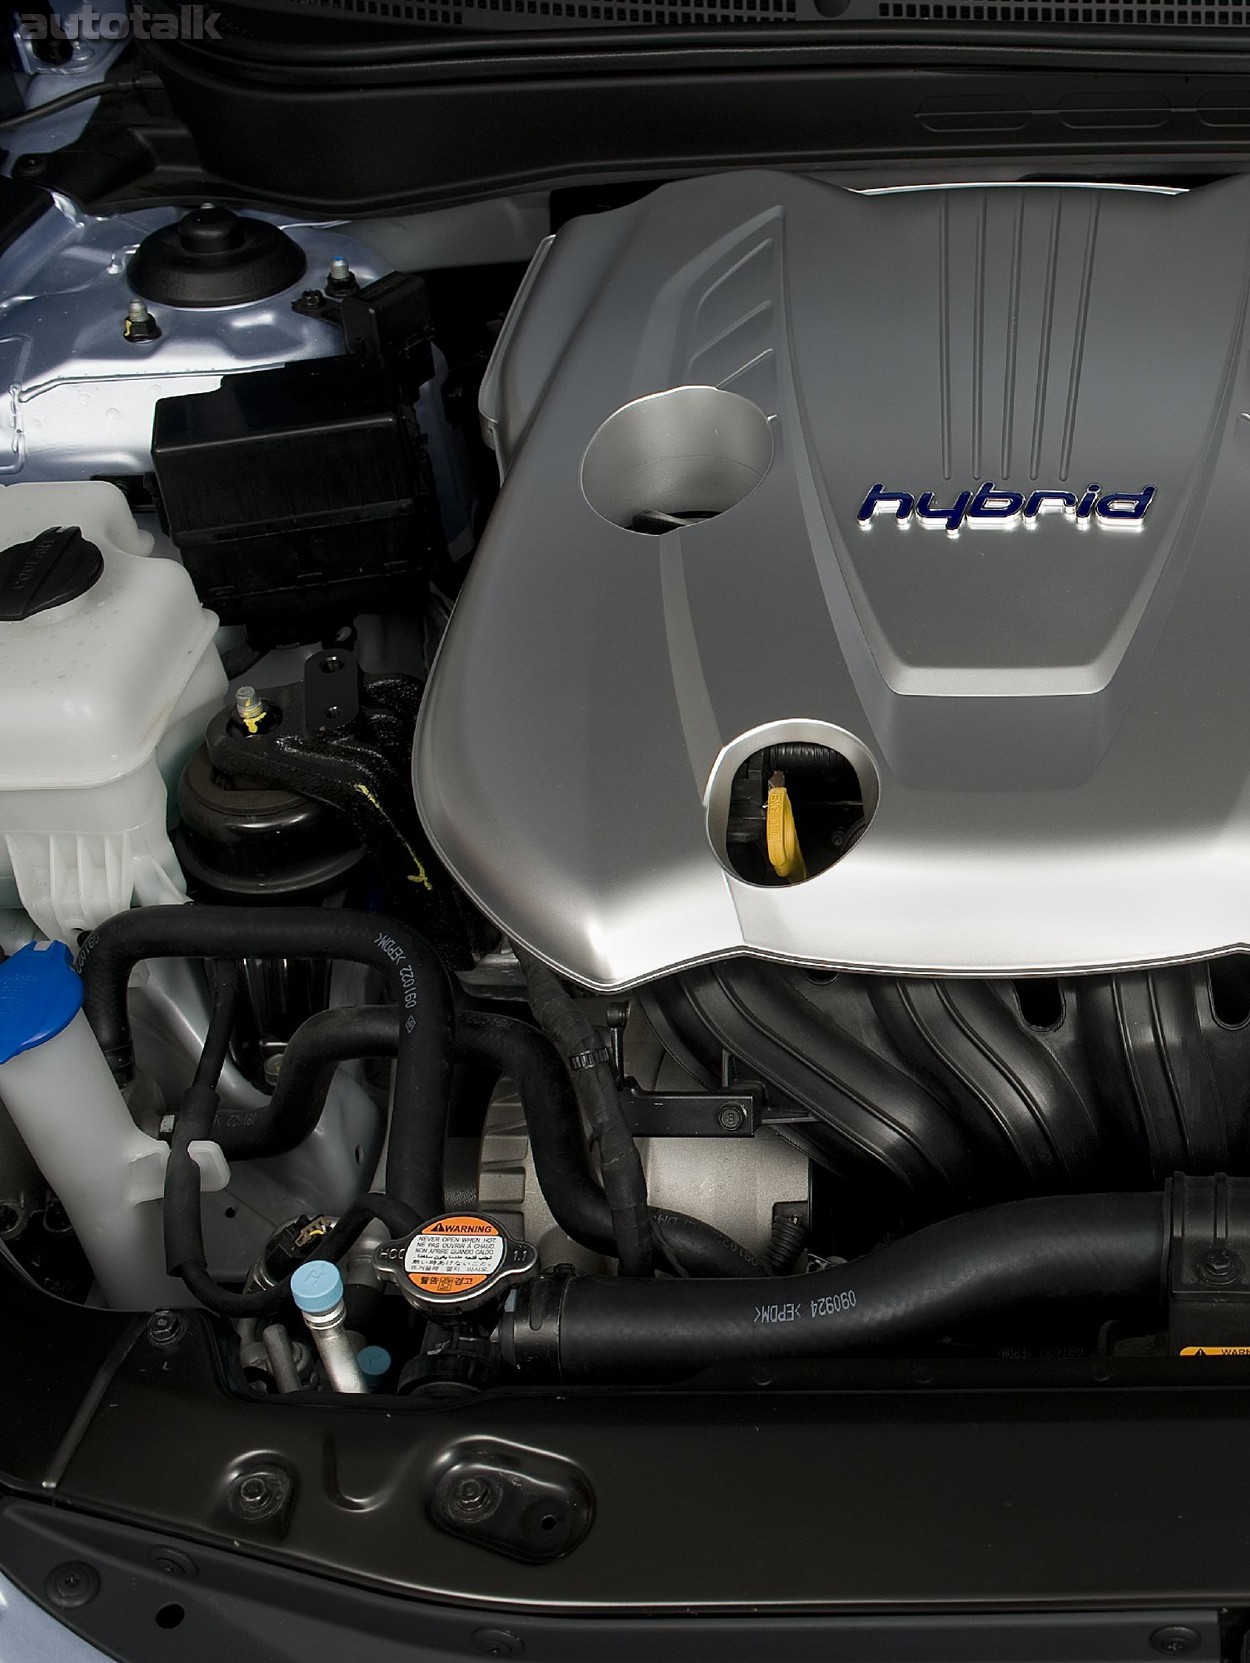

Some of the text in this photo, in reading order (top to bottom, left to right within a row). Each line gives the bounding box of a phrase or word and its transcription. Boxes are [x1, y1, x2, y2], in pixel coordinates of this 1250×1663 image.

[856, 481, 1157, 535] hybrid
[445, 1225, 492, 1233] WARNING
[810, 1289, 857, 1318] 090924
